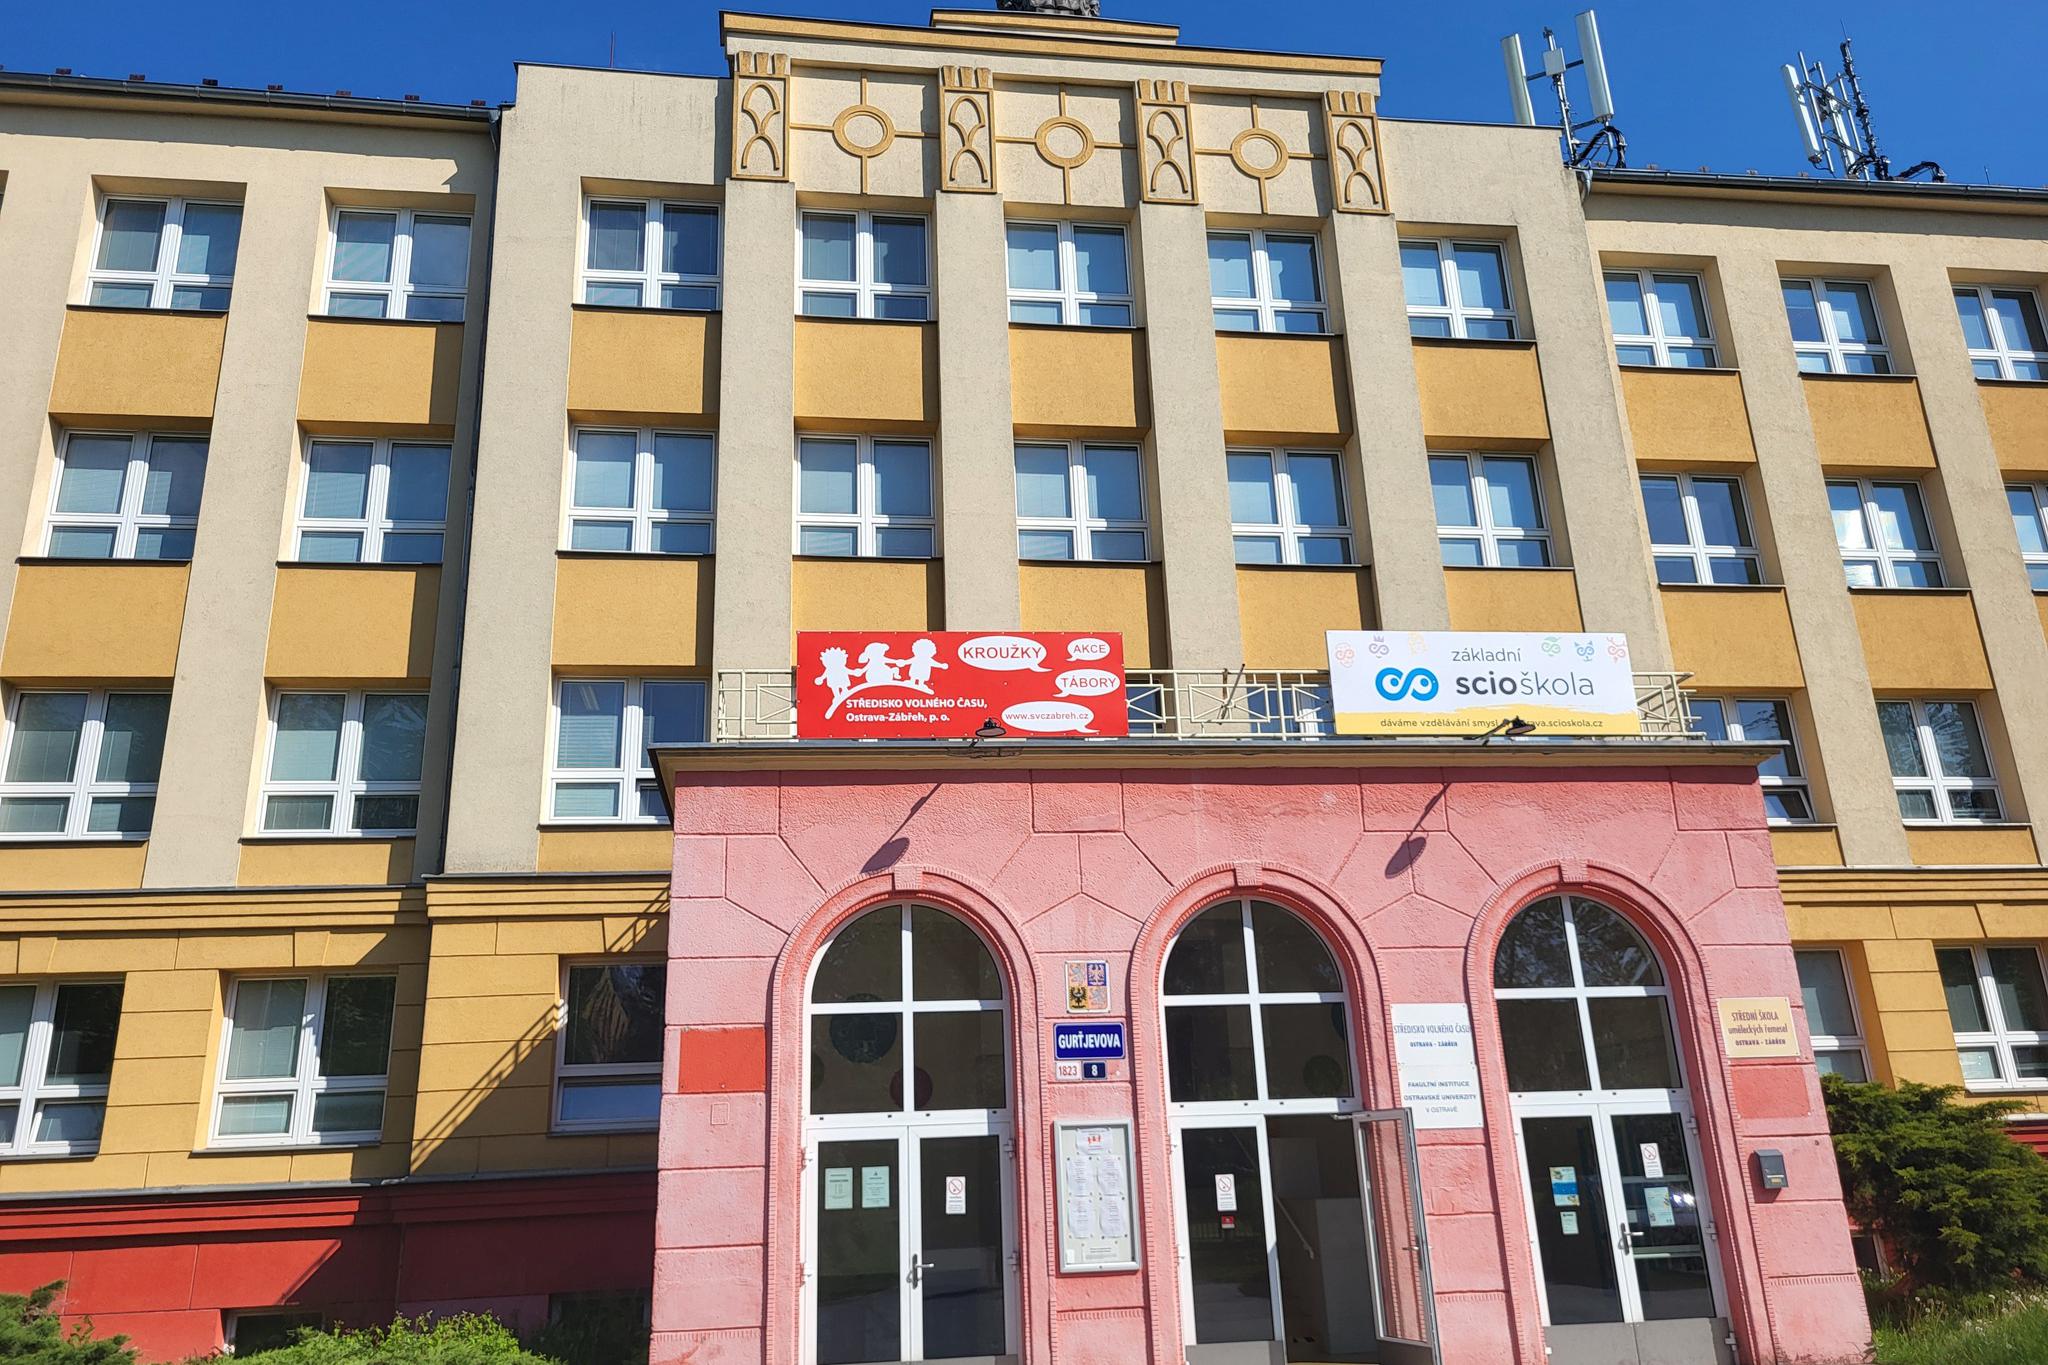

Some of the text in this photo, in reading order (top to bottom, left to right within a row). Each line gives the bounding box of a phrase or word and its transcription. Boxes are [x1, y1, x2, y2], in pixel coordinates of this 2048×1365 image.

[963, 644, 1043, 659] KROUŽKY
[1073, 644, 1107, 654] AKCE
[1452, 647, 1522, 662] základní
[1060, 675, 1117, 688] TÁBORY
[1456, 670, 1595, 696] scioškola
[846, 696, 988, 709] STŘEDISKO VOLNÉHO ČASU,
[846, 711, 950, 723] Ostrava-Zábřeh, p. o.
[1005, 712, 1089, 720] www.svczabreh.cz
[1380, 719, 1418, 728] dáváme
[1420, 719, 1471, 728] vzdělávání
[1472, 718, 1498, 729] smysl
[1731, 1009, 1779, 1021] STŘEDNÍ ŠKOLA
[1394, 1022, 1425, 1034] STŘEDISKO
[1426, 1022, 1453, 1033] VOLNÉHO
[1728, 1024, 1764, 1035] uměleckých
[1058, 1031, 1121, 1049] GURŤJEVOVA
[1059, 1065, 1078, 1076] 1823
[1091, 1064, 1098, 1076] 8
